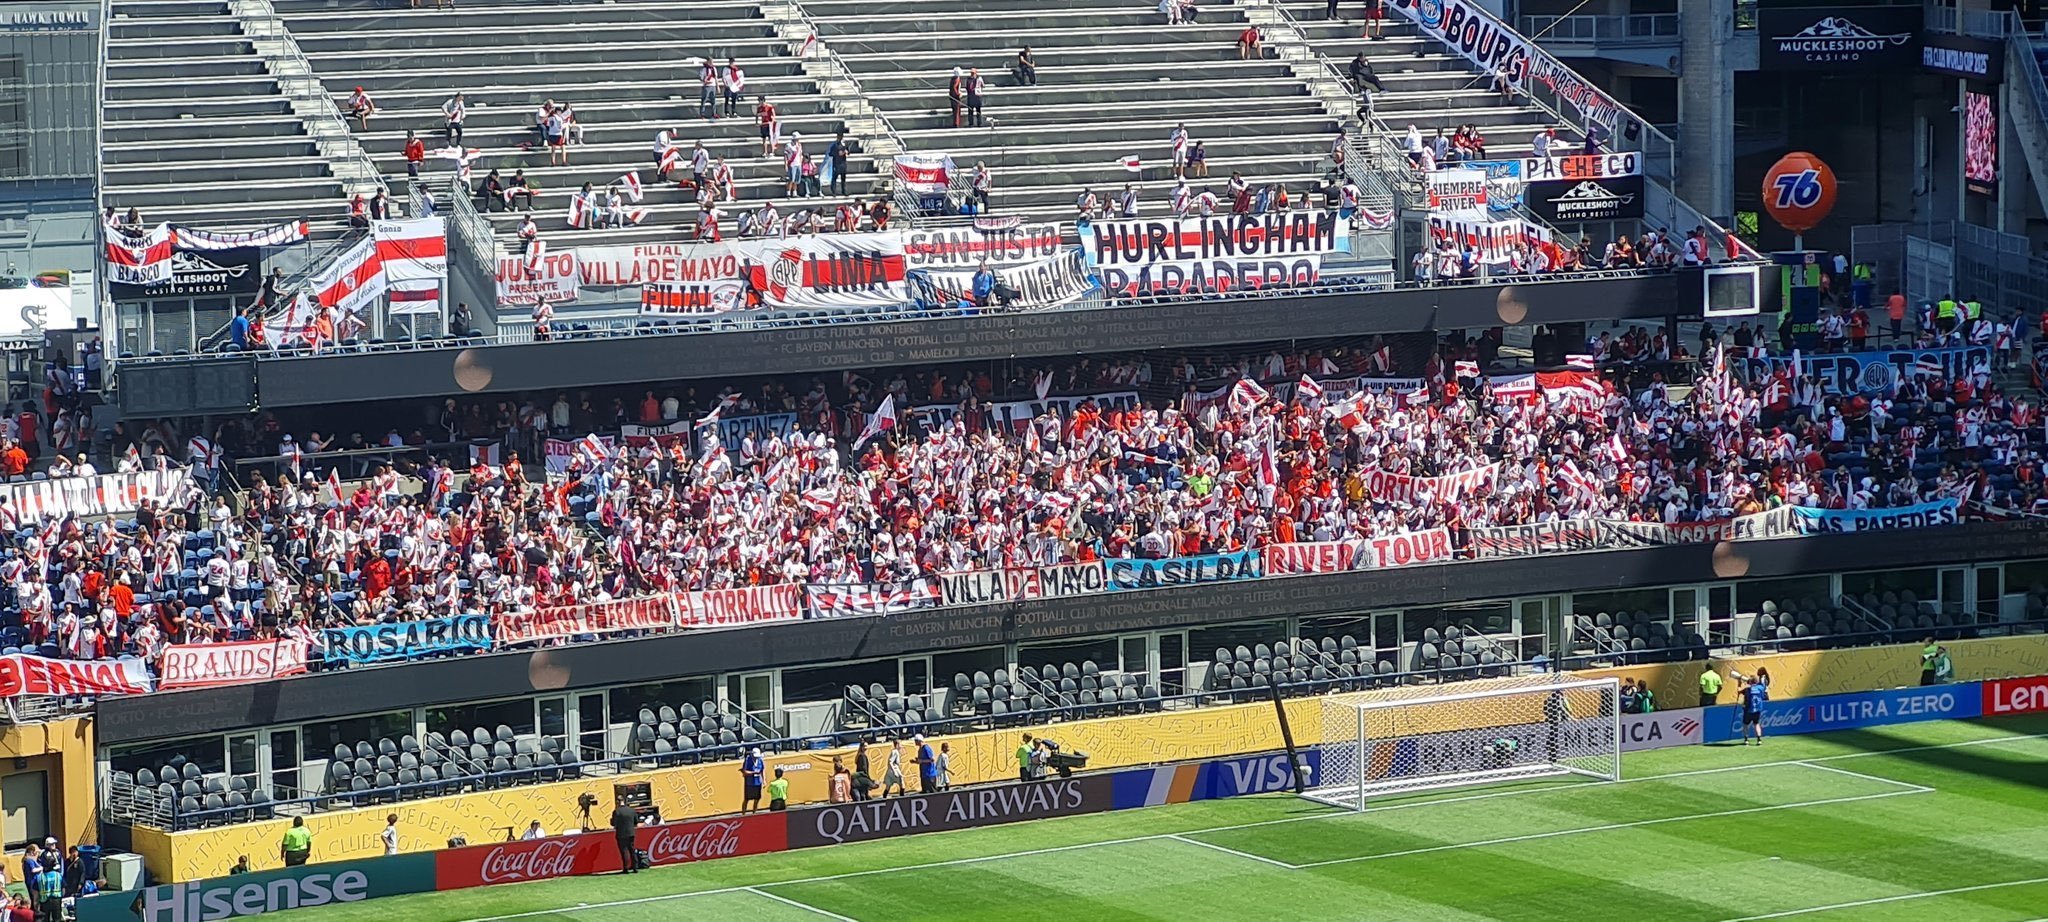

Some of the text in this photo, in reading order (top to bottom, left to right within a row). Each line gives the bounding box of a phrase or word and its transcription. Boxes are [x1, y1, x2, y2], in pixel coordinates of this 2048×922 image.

[13, 10, 89, 24] HAWK TOWER
[1779, 40, 1886, 51] MUCKLESHOOT
[1806, 53, 1860, 61] CASINO
[1530, 54, 1616, 130] LOS PIBES DEL VINO
[1526, 153, 1635, 179] PACHECO
[1433, 181, 1482, 196] SIEMPRE
[1440, 197, 1477, 212] RIVER
[1557, 200, 1619, 212] MUCKLESHOOT
[1773, 168, 1822, 208] 76
[1557, 211, 1586, 220] CASINO
[634, 245, 683, 257] FILIAL
[910, 228, 1058, 264] SAN JUSTO
[1093, 212, 1339, 263] HURLINGHAM
[118, 264, 160, 283] BLASCO
[509, 281, 559, 293] PRESENTE
[580, 255, 736, 285] VILLA DE MAYO
[808, 250, 888, 293] LIMA
[188, 284, 228, 293] RESORT
[645, 282, 715, 312] FILIAL
[750, 332, 775, 342] LATE
[786, 330, 810, 341] CLUB
[814, 329, 827, 340] DE
[869, 323, 926, 336] MONTERREY
[964, 318, 977, 330] DE
[781, 342, 793, 353] FC
[796, 340, 833, 353] BAYERN
[894, 334, 940, 347] FOOTBALL
[1051, 324, 1088, 338] MILANO
[637, 426, 675, 435] FILIAL
[102, 473, 136, 513] DEL
[1855, 505, 1954, 531] PAREDES
[1268, 529, 1450, 574] RIVER TOUR
[942, 564, 1100, 606] VILLA DE MAYO
[1111, 553, 1253, 590] CASILDA
[502, 599, 671, 641] ESTAMOS ENFERMOS
[679, 584, 798, 625] EL CORRALITO
[890, 626, 904, 637] FC
[906, 622, 946, 636] BAYERN
[1070, 607, 1096, 619] CLUB
[1100, 598, 1188, 617] INTERNAZIONALE
[1191, 593, 1233, 609] MILANO
[326, 615, 483, 660] ROSARIO
[0, 656, 144, 694] BERNAL
[167, 642, 306, 681] BRANDSEN
[1732, 692, 1955, 733] ichelob ULTRA ZERO
[816, 779, 1083, 843] QATAR AIRWAYS
[648, 820, 743, 863] Coca-Cola
[481, 838, 580, 883] Coca-Cola
[147, 869, 369, 922] Hisense
